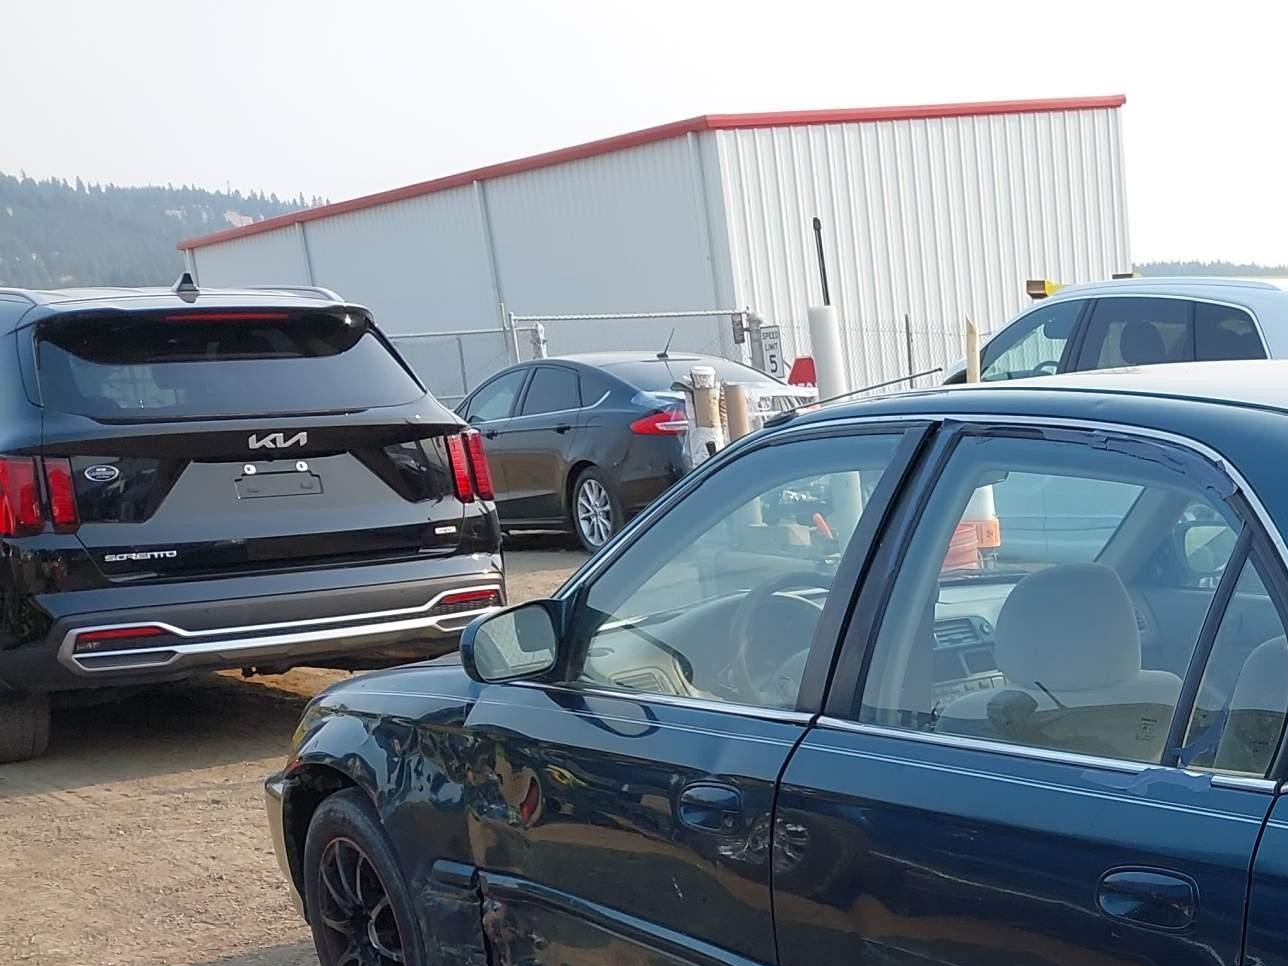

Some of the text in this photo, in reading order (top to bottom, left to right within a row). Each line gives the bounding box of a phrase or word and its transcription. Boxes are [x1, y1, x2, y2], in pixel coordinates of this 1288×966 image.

[762, 331, 779, 341] SPEED
[764, 343, 779, 352] LIMIT
[769, 355, 778, 373] 5
[248, 431, 308, 449] KIA
[104, 550, 177, 562] SORENTO
